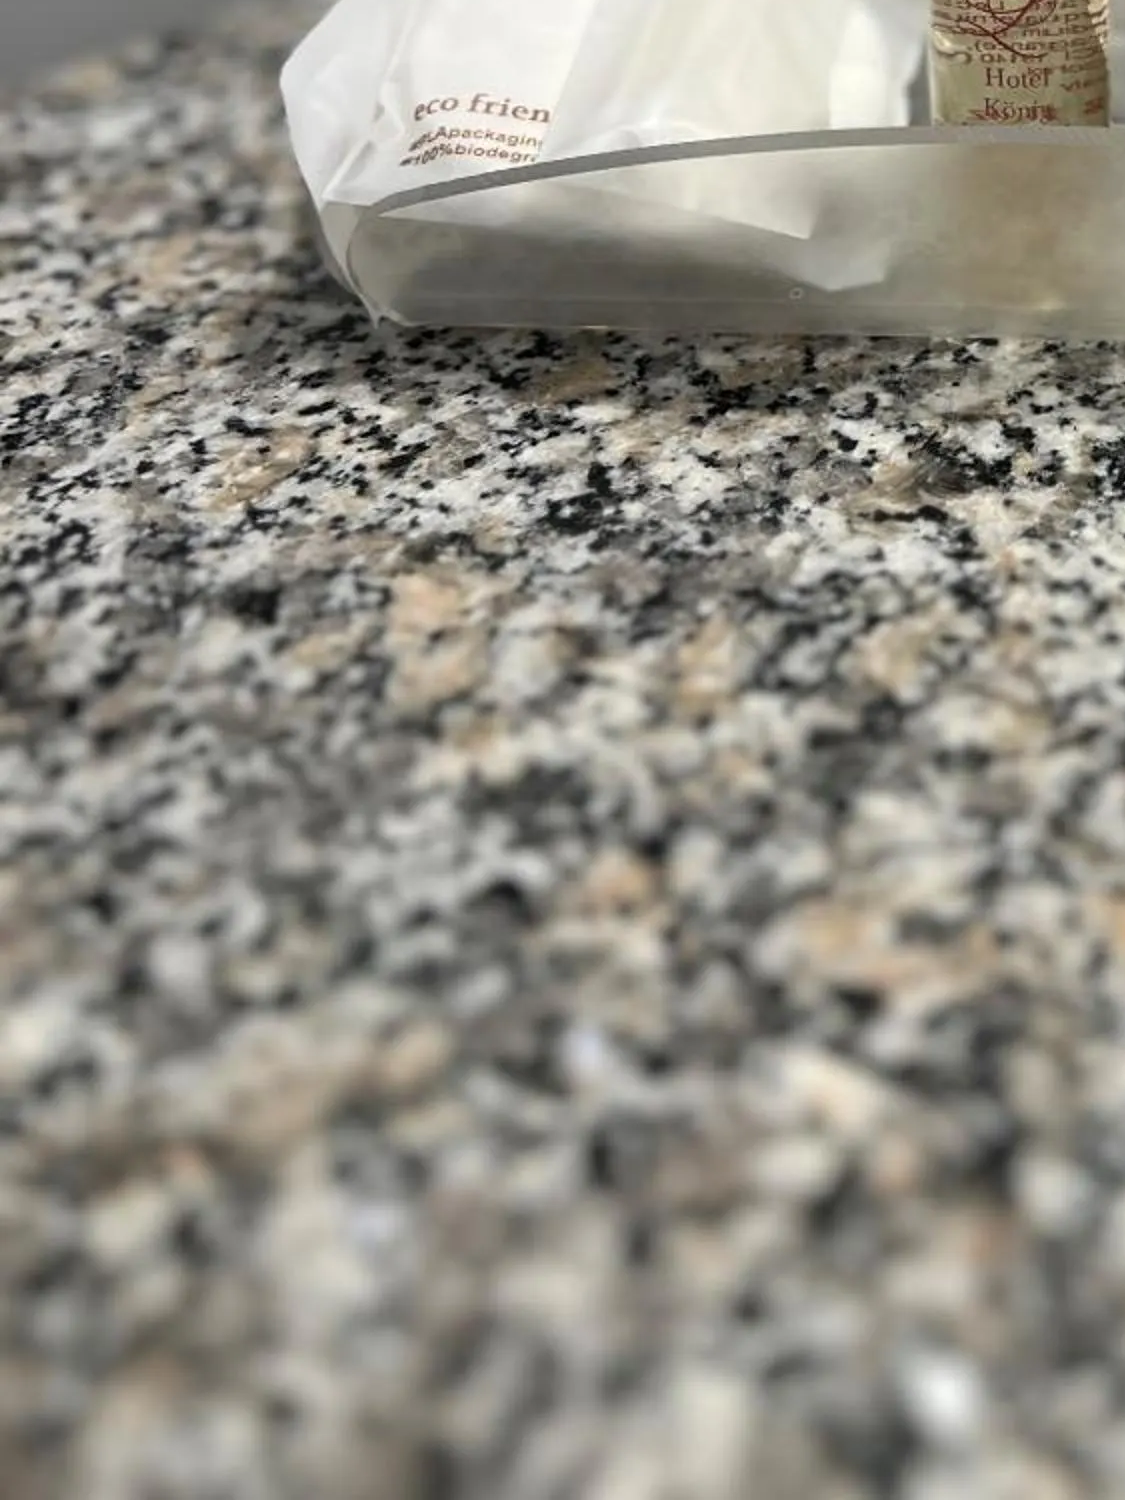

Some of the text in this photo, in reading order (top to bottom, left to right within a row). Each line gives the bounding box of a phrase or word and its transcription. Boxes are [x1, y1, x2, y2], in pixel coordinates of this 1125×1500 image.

[985, 68, 1049, 89] Hotel
[415, 93, 550, 123] eco frien
